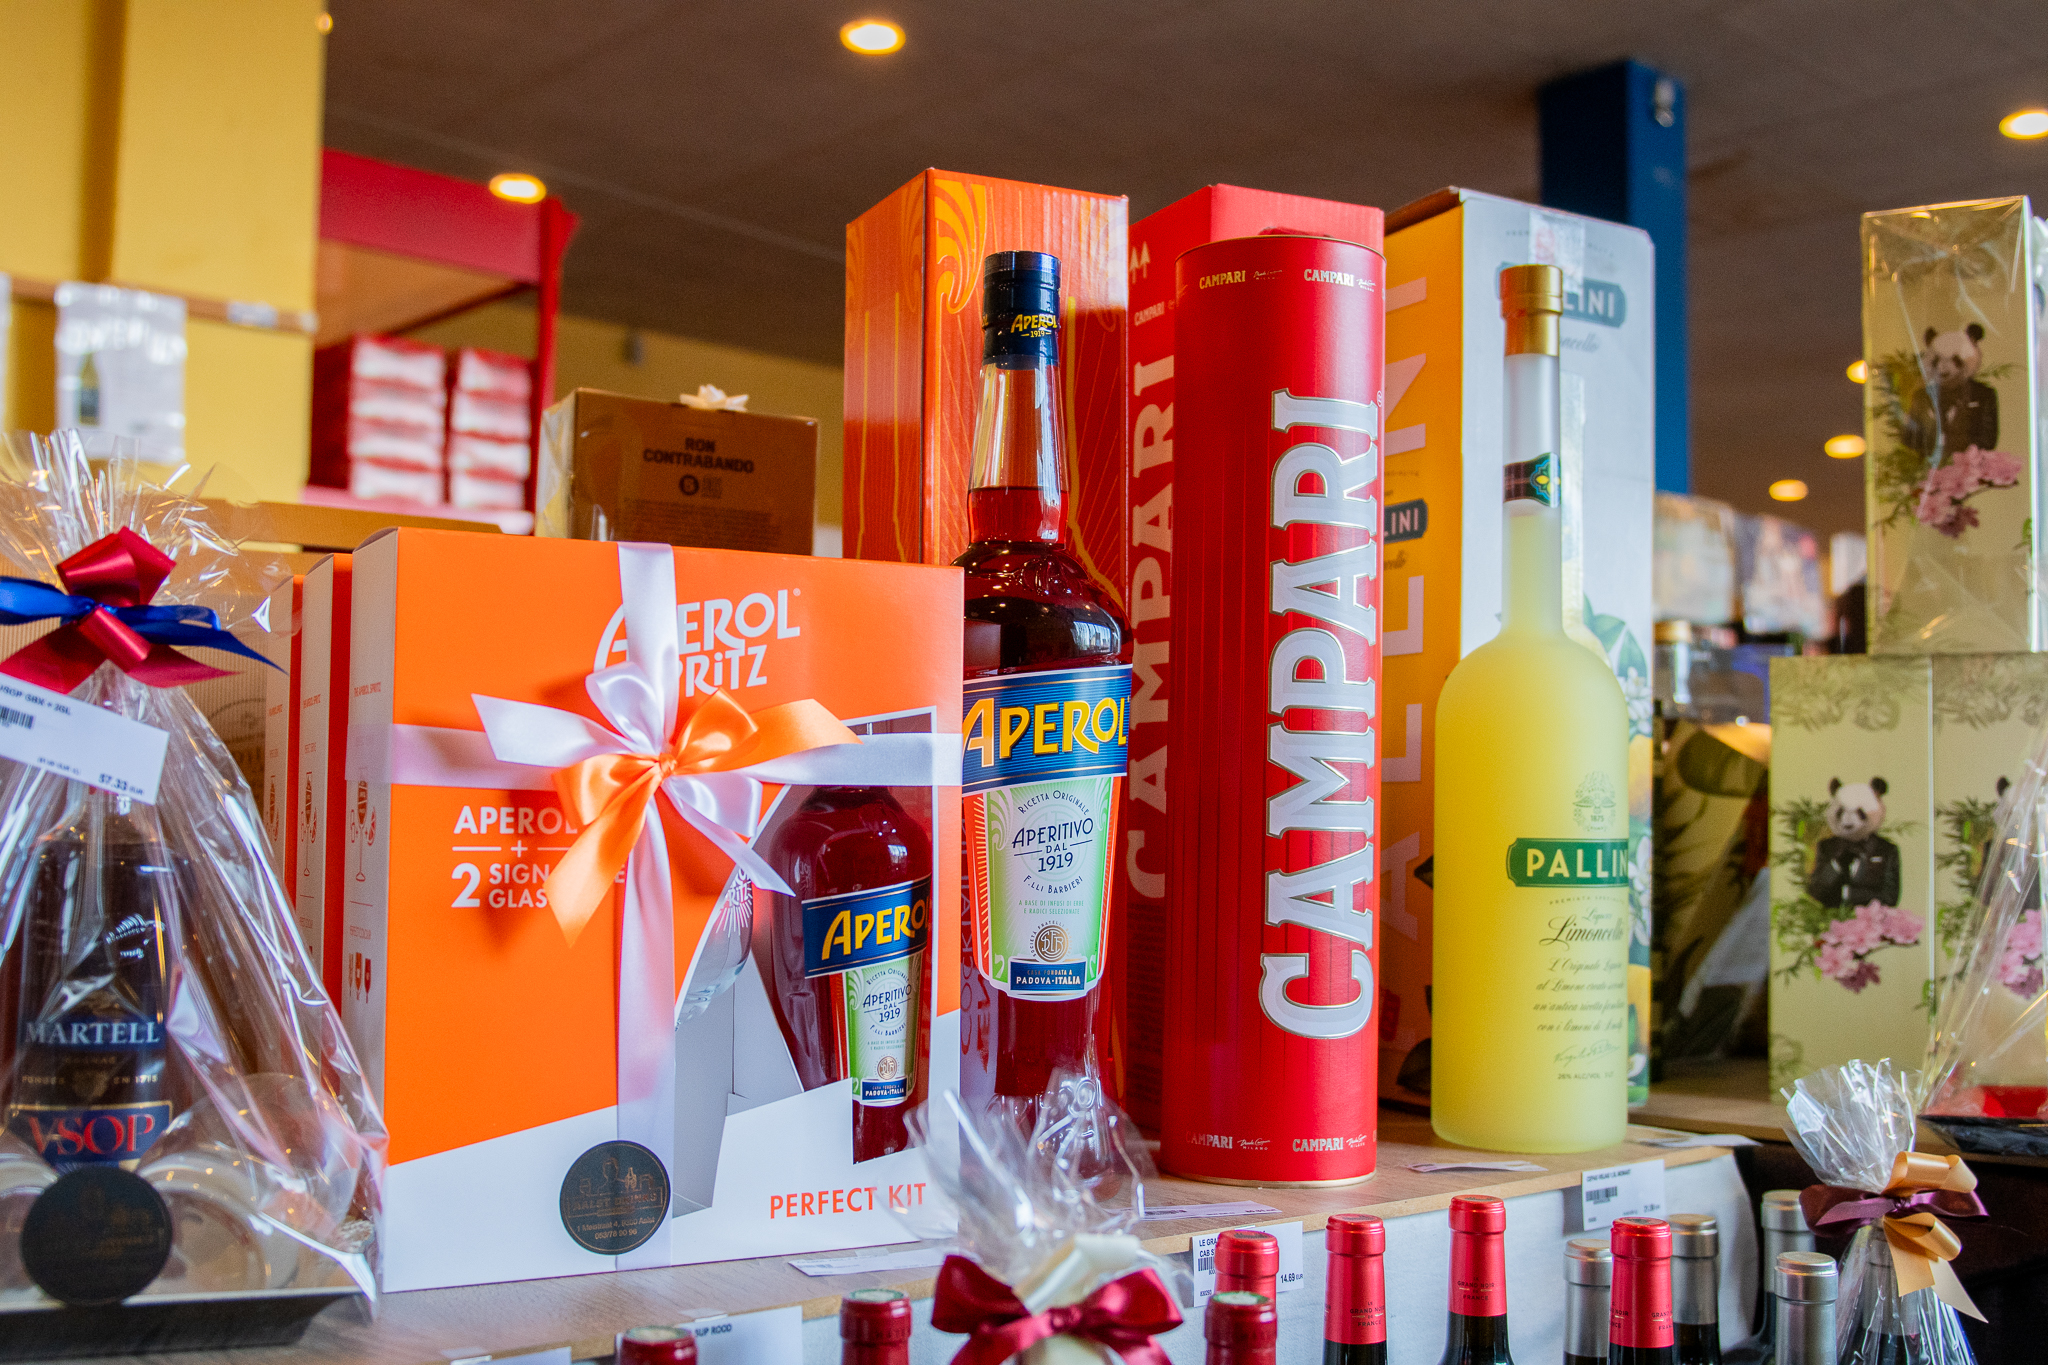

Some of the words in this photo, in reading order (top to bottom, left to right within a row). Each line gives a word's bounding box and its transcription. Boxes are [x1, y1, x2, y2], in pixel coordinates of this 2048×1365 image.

[1199, 270, 1246, 289] CAMPARI
[1303, 268, 1354, 288] CAMPARI
[1010, 313, 1058, 333] APEROL
[1134, 301, 1165, 327] CAMPARI
[1030, 330, 1045, 338] 1919
[685, 438, 715, 452] RON
[643, 449, 754, 473] CONTRABANDO
[1127, 354, 1174, 900] CAMPARI
[1260, 388, 1378, 1041] CAMPARI
[962, 697, 1127, 768] APEROL
[1018, 792, 1050, 814] RICETTA
[1053, 790, 1090, 815] ORIGINALE
[453, 806, 578, 835] APEROL
[1012, 817, 1094, 848] APERITIVO
[1045, 842, 1068, 854] DAL
[1038, 852, 1074, 873] 1919
[451, 862, 481, 908] 2
[1023, 875, 1044, 892] F.LLI
[1047, 876, 1083, 894] BARBIERI
[488, 888, 548, 909] GLAS
[866, 971, 886, 985] RICETTA
[863, 984, 912, 1008] APERITIVO
[884, 1002, 897, 1010] DAL
[879, 1007, 901, 1023] 1919
[24, 1021, 160, 1045] MARTELL
[28, 1113, 156, 1156] VSOP
[1186, 1131, 1233, 1149] CAMPARI
[1292, 1137, 1344, 1152] CAMPARI
[770, 1186, 877, 1219] PERFECT
[889, 1183, 926, 1208] KIT
[1199, 1239, 1206, 1247] LE
[1206, 1237, 1218, 1246] GRA
[1281, 1273, 1295, 1283] 14.69
[1457, 1280, 1479, 1288] GRAND
[1357, 1319, 1382, 1327] FRANCE
